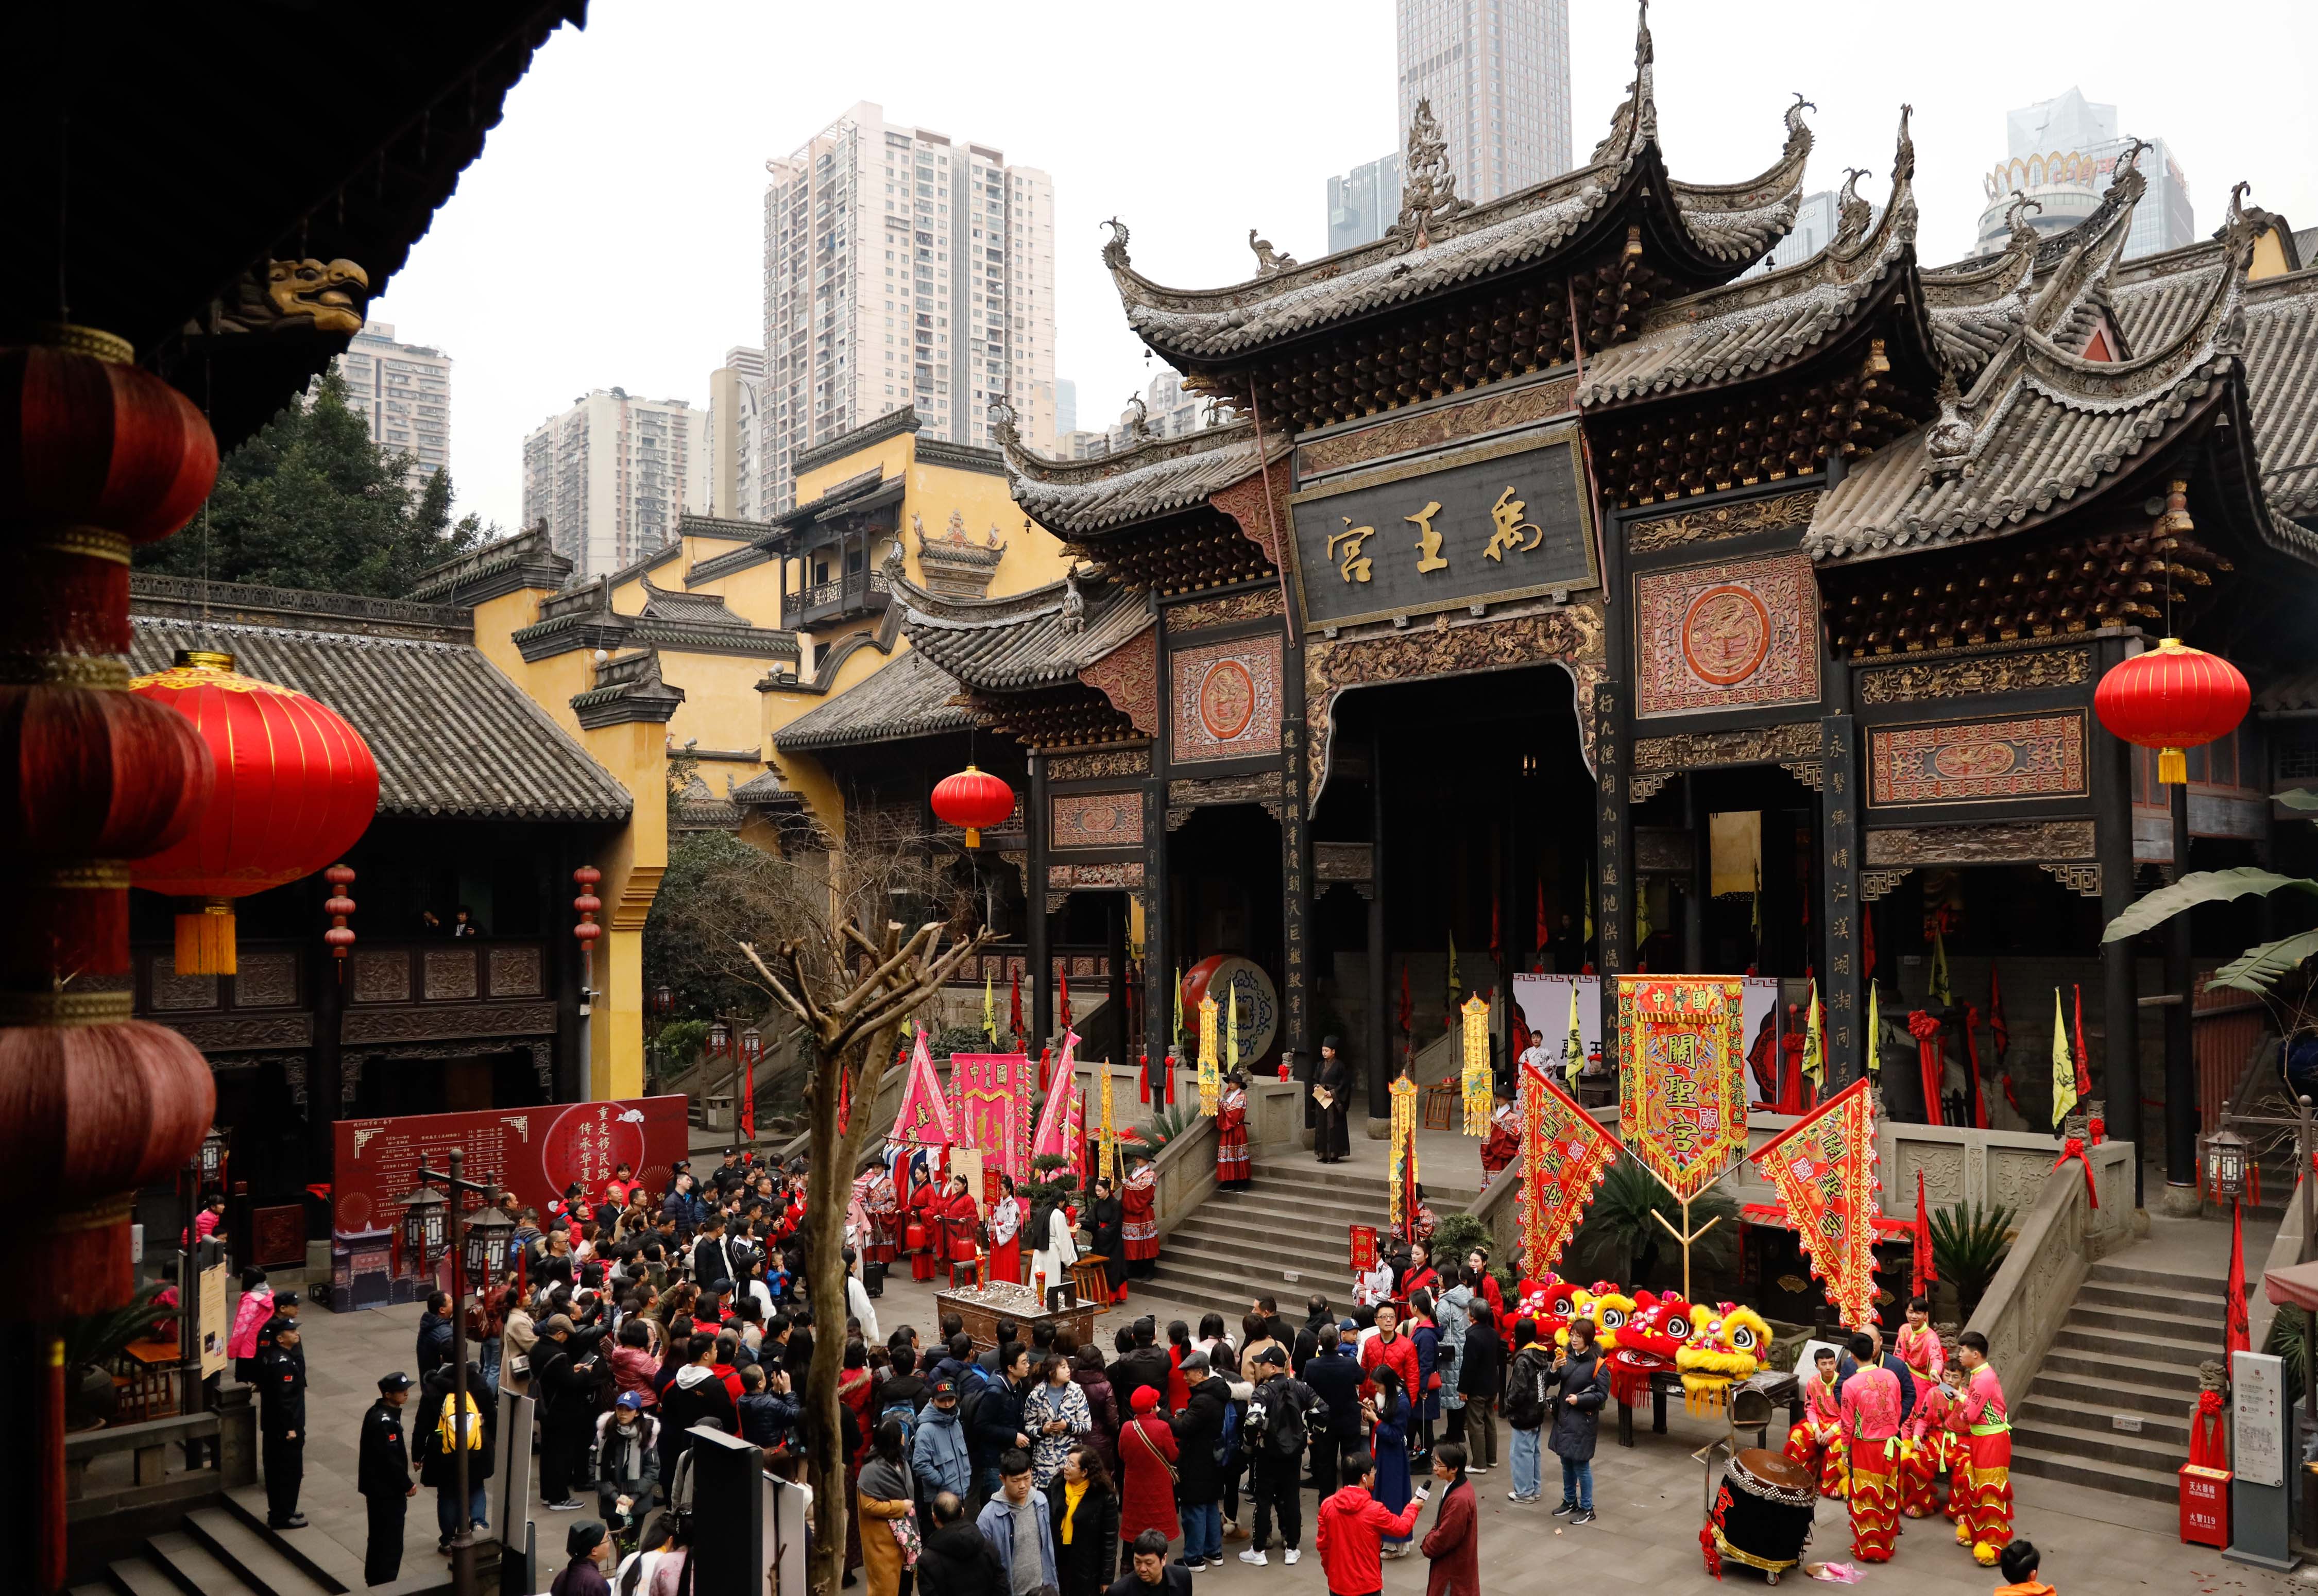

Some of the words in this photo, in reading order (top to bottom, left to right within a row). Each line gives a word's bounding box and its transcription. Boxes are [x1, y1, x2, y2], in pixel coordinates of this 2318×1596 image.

[578, 1122, 594, 1197] 传承华夏礼
[597, 1106, 611, 1180] 重走移民路
[2189, 1481, 2215, 1495] 灭火器箱
[2189, 1512, 2215, 1525] 火警119
